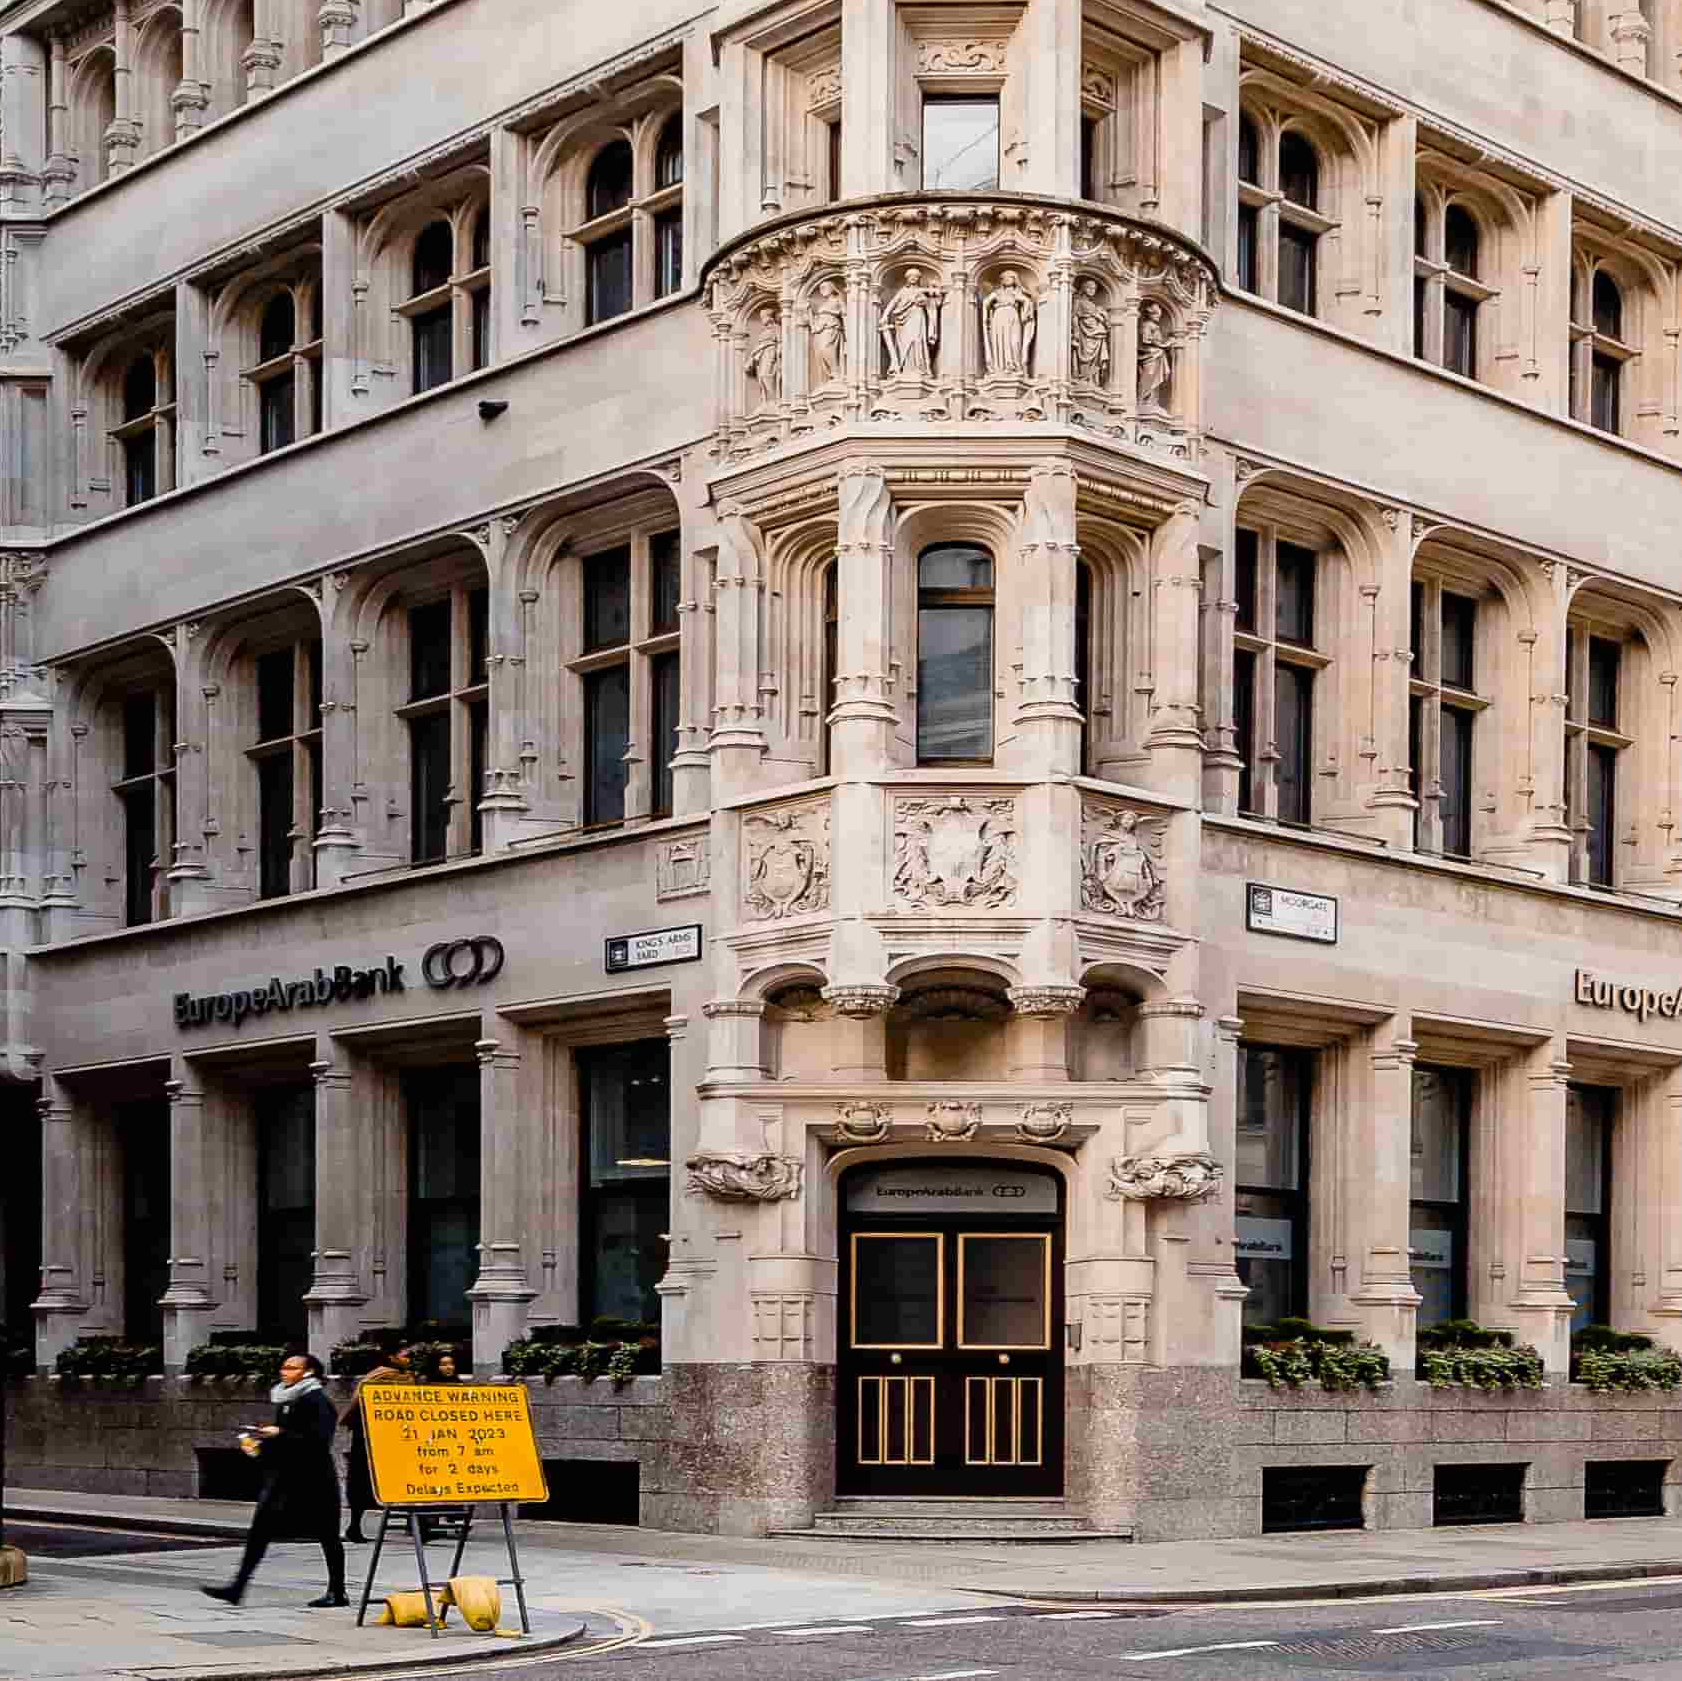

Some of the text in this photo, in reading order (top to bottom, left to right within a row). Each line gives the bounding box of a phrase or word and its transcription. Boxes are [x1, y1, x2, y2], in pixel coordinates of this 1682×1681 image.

[173, 955, 406, 1029] EuropeArabBank
[372, 1390, 519, 1403] ADVANCE WARNING
[374, 1409, 524, 1422] ROAD CLOSED HERE
[430, 1428, 457, 1439] JAN
[469, 1428, 506, 1440] 2023
[417, 1446, 449, 1456] from
[474, 1447, 494, 1456] am
[419, 1463, 499, 1477] for 2 days
[406, 1482, 519, 1496] Delays Expected
